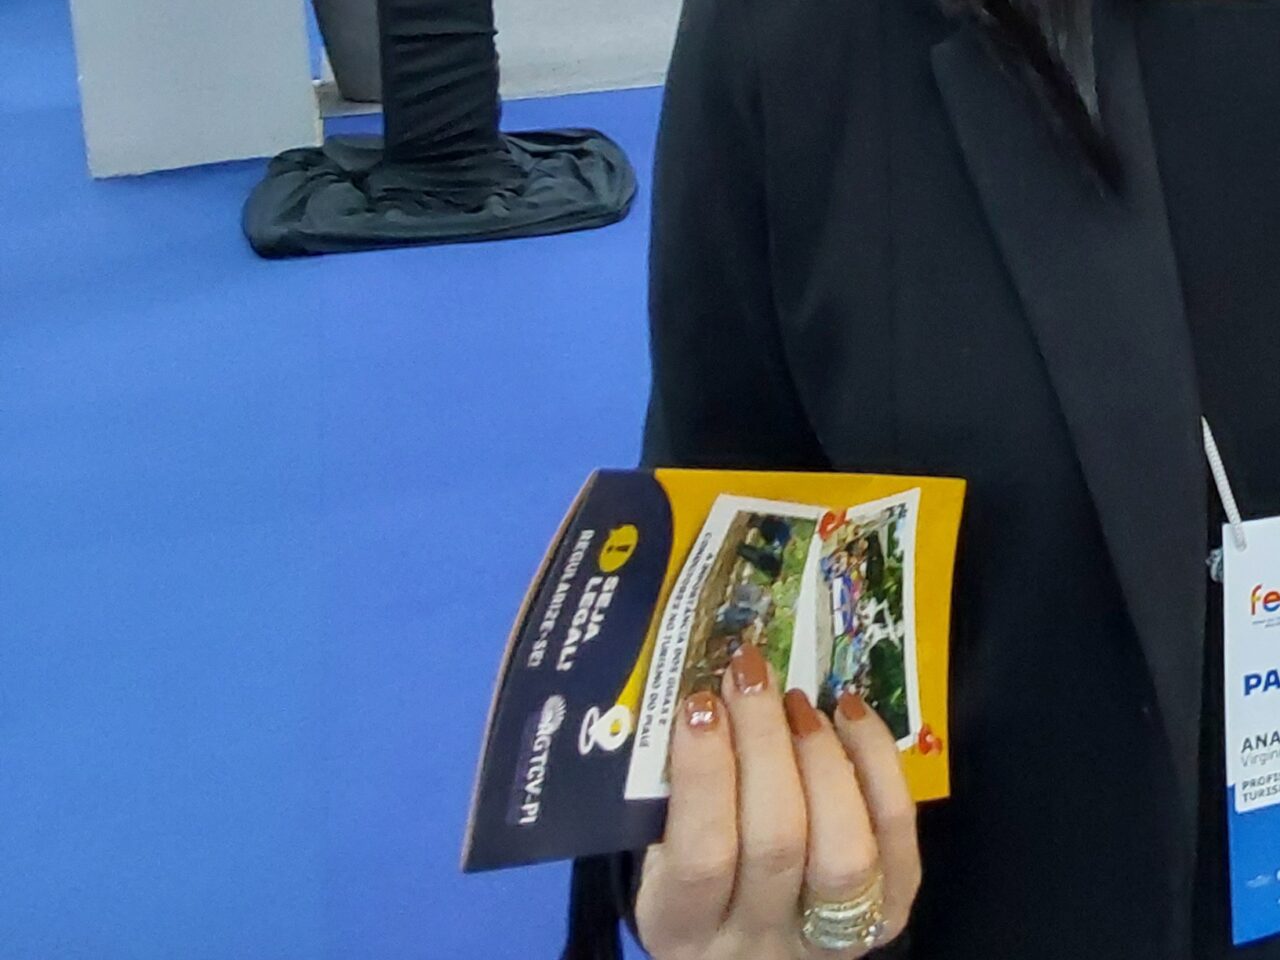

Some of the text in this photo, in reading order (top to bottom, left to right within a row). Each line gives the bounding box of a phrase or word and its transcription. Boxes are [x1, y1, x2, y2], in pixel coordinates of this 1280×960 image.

[556, 576, 603, 671] LEGAL!
[582, 576, 619, 642] SEJA
[666, 613, 677, 631] NO
[651, 635, 672, 689] TURISMO
[647, 692, 658, 711] DO
